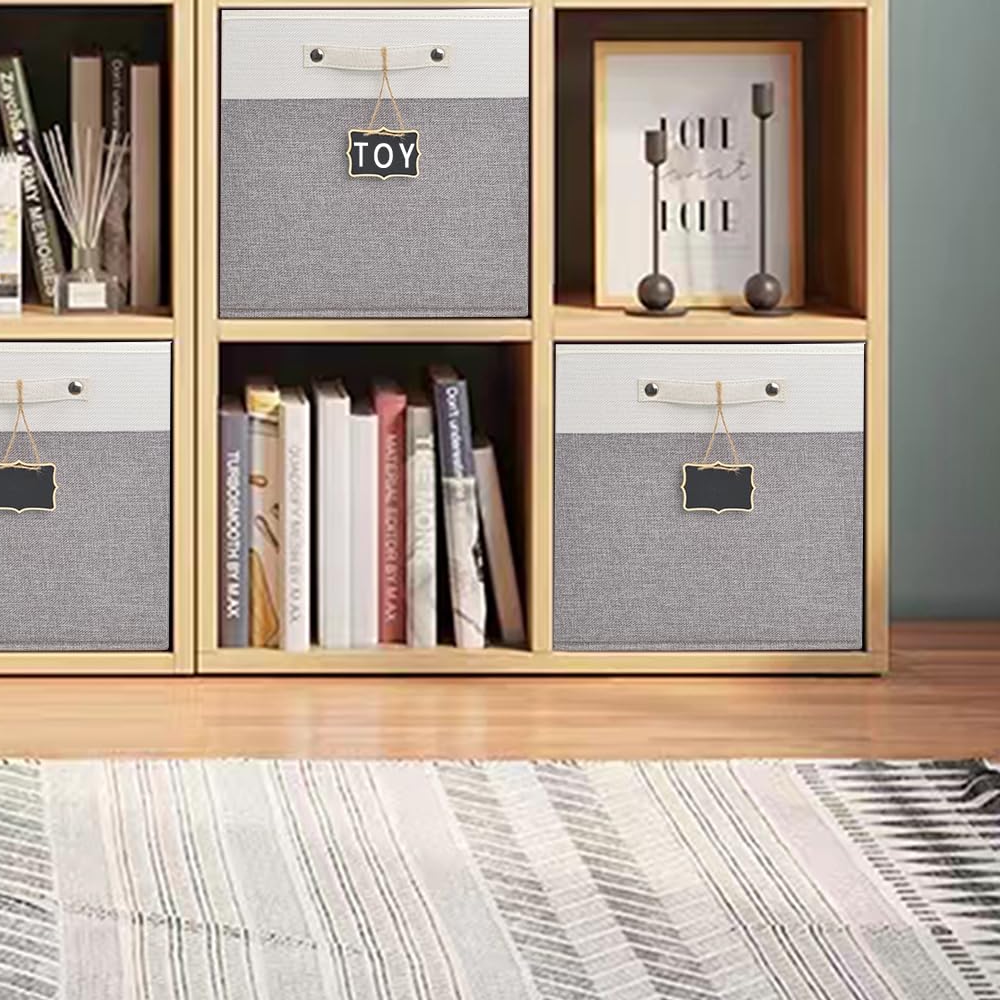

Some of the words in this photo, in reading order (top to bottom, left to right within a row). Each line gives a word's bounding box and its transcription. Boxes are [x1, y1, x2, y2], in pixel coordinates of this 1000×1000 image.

[353, 142, 415, 169] TOY
[225, 450, 240, 559] TURBOSMOOTH
[225, 561, 240, 580] BY
[225, 582, 240, 619] MAX
[384, 586, 399, 624] MAX
